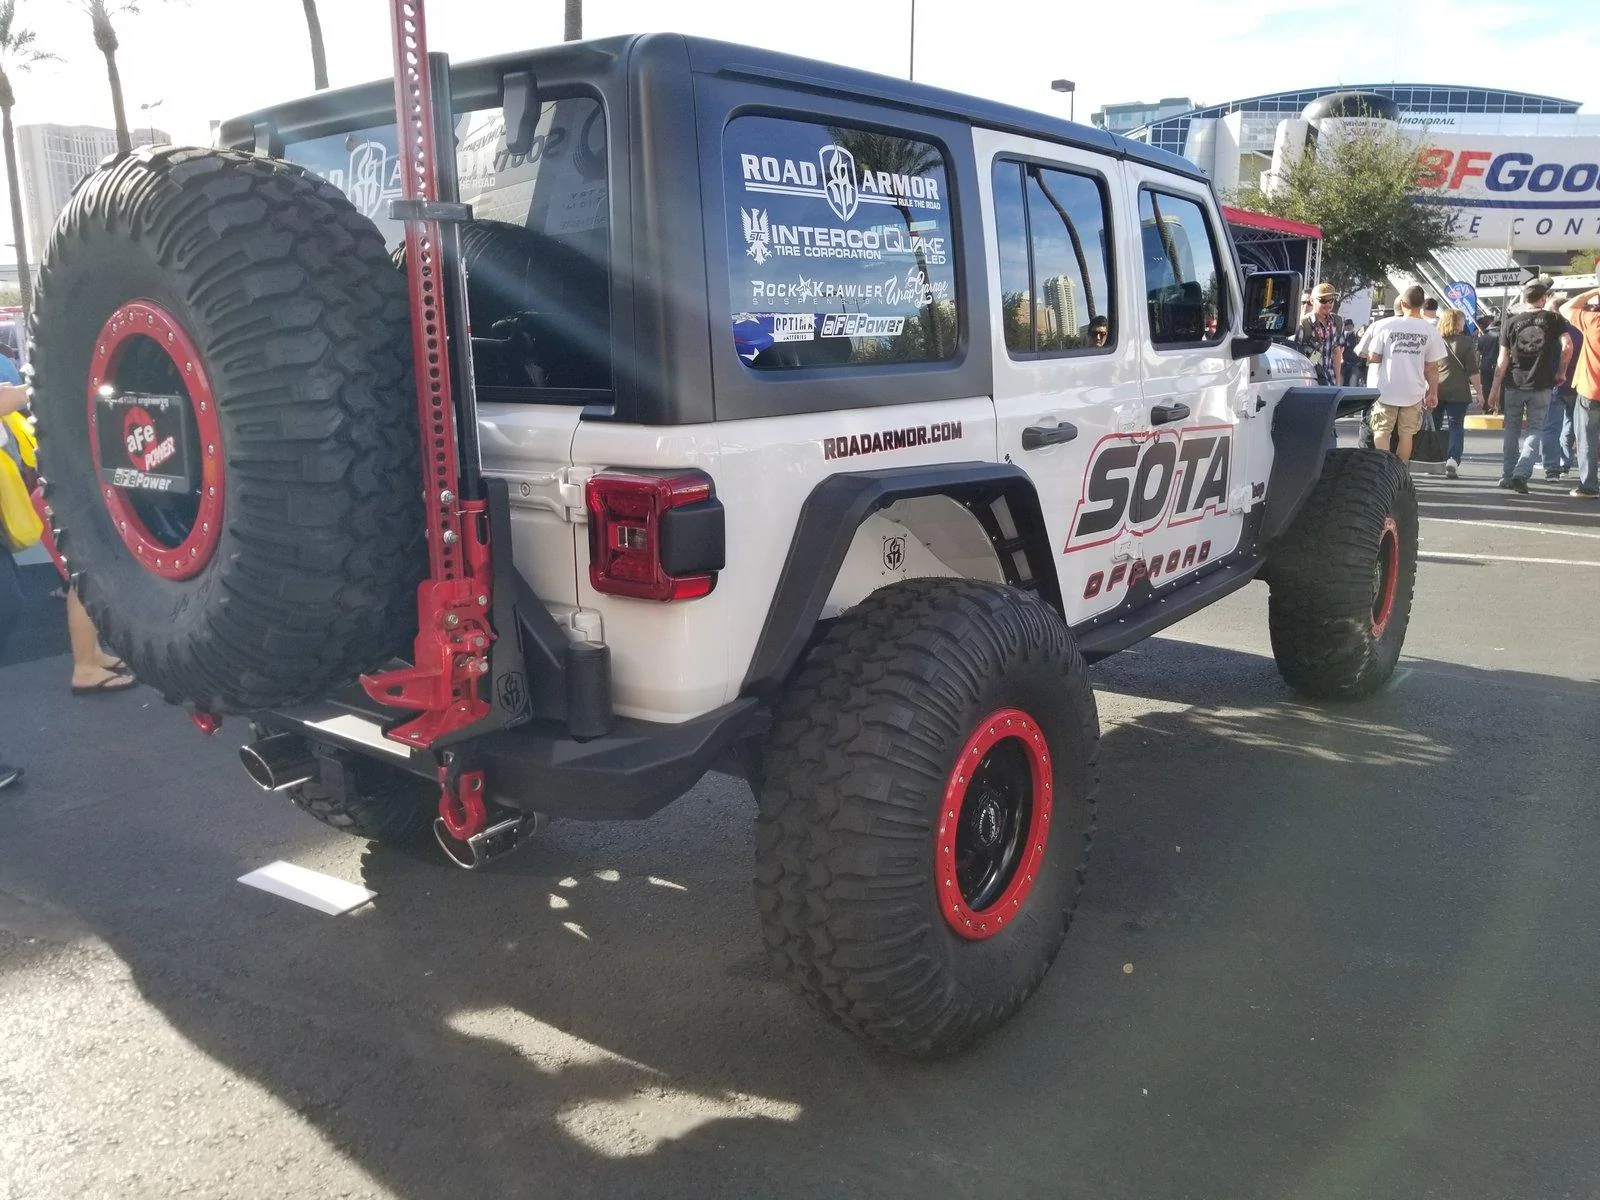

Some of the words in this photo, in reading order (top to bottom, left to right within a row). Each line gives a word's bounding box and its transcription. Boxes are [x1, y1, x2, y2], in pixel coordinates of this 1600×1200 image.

[1402, 117, 1456, 126] MONORAIL
[741, 154, 818, 187] ROAD
[862, 170, 940, 200] ARMOR
[1416, 149, 1600, 193] BFGoo
[899, 198, 913, 207] RULE
[914, 200, 925, 208] THE
[926, 201, 941, 210] ROAD
[771, 224, 880, 249] INTERCO
[884, 227, 946, 255] QUAKE
[774, 245, 801, 256] TIRE
[804, 247, 882, 260] CORPORATION
[925, 254, 947, 265] LED
[750, 280, 797, 297] ROCK
[812, 281, 883, 298] KRAWLER
[885, 275, 914, 305] Wrap
[907, 271, 949, 308] Garage
[1482, 274, 1499, 283] ONE
[1501, 272, 1519, 282] WAY
[126, 425, 155, 453] aFe
[823, 421, 963, 460] ROADARMOR.COM
[144, 436, 176, 471] POWER
[1074, 435, 1231, 538] SOTA
[1083, 540, 1211, 600] OFFROAD
